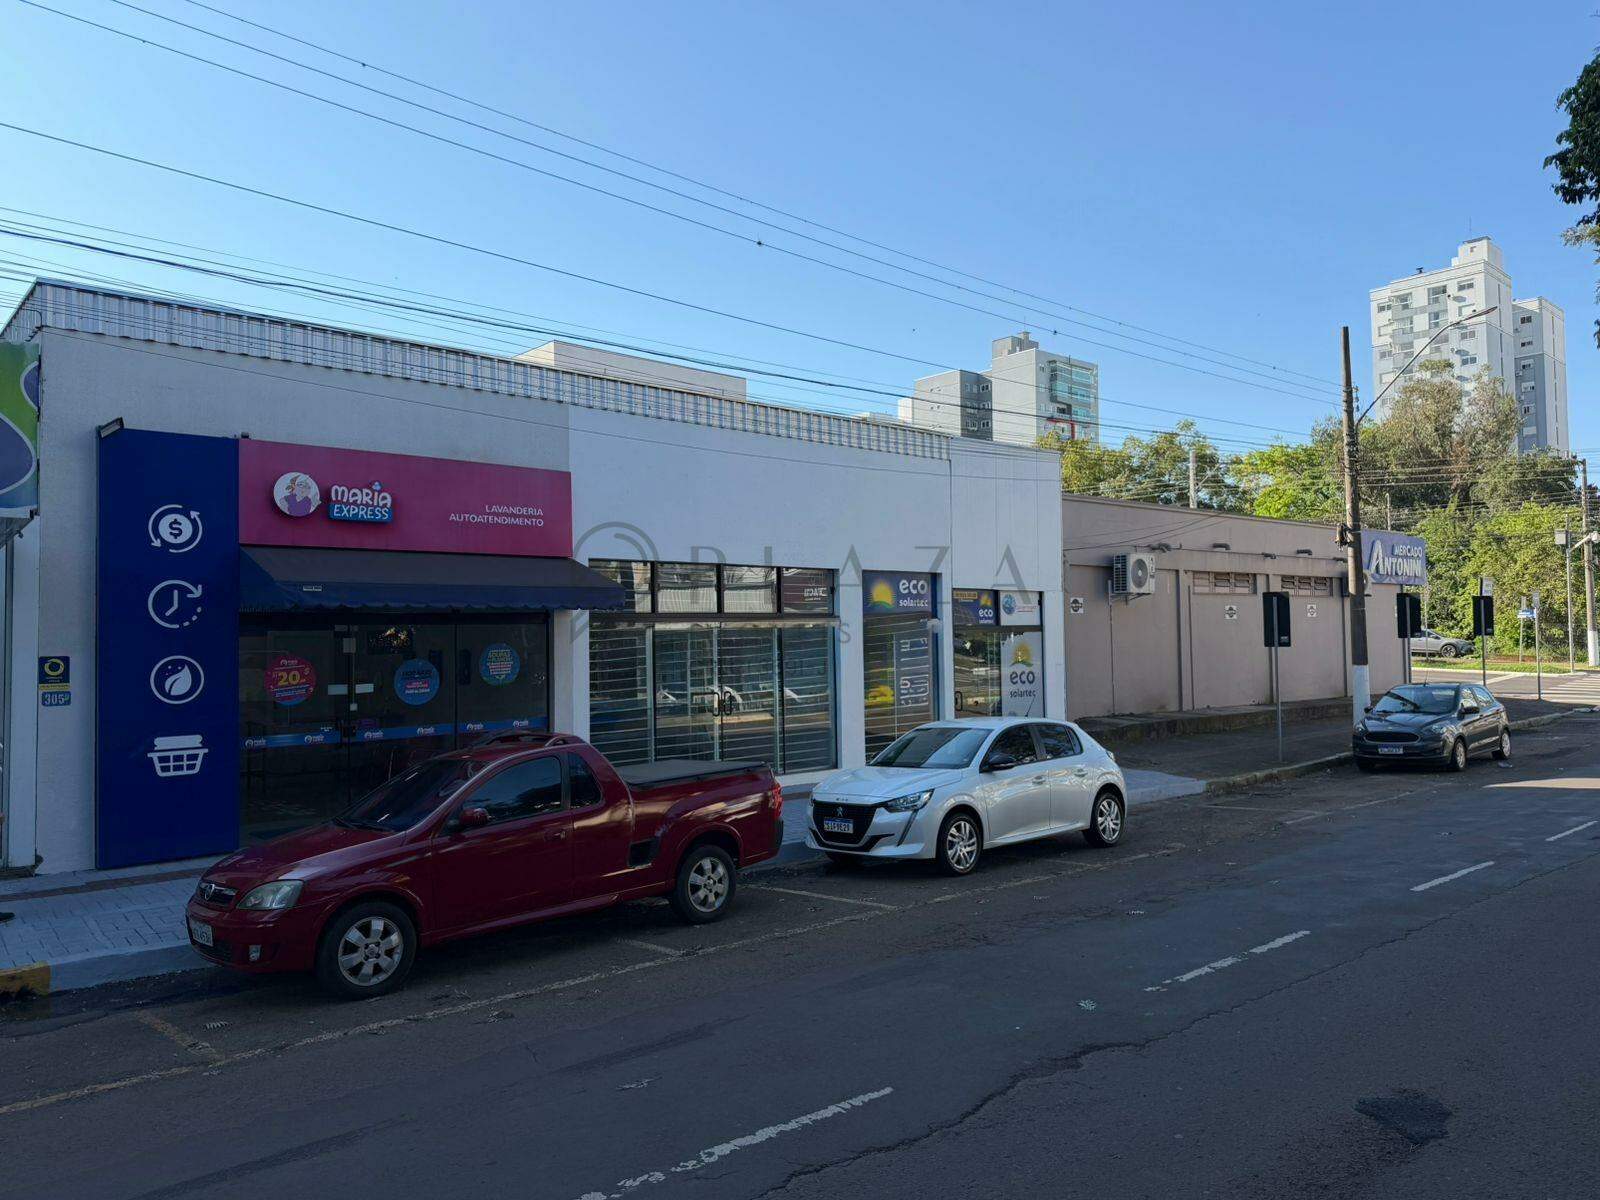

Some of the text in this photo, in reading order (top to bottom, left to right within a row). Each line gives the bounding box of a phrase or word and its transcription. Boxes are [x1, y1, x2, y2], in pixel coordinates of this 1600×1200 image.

[333, 504, 389, 521] EXPRESS
[485, 504, 544, 517] LAVANDERIA
[449, 512, 544, 528] AUTOATENDIMENTO
[1370, 540, 1422, 577] ANTONINI
[1394, 544, 1423, 558] MERCADO
[899, 579, 928, 594] eco
[899, 598, 929, 607] solartec
[979, 608, 994, 618] eco
[278, 671, 301, 686] 20
[1009, 670, 1035, 685] eco
[1009, 688, 1037, 699] solartec
